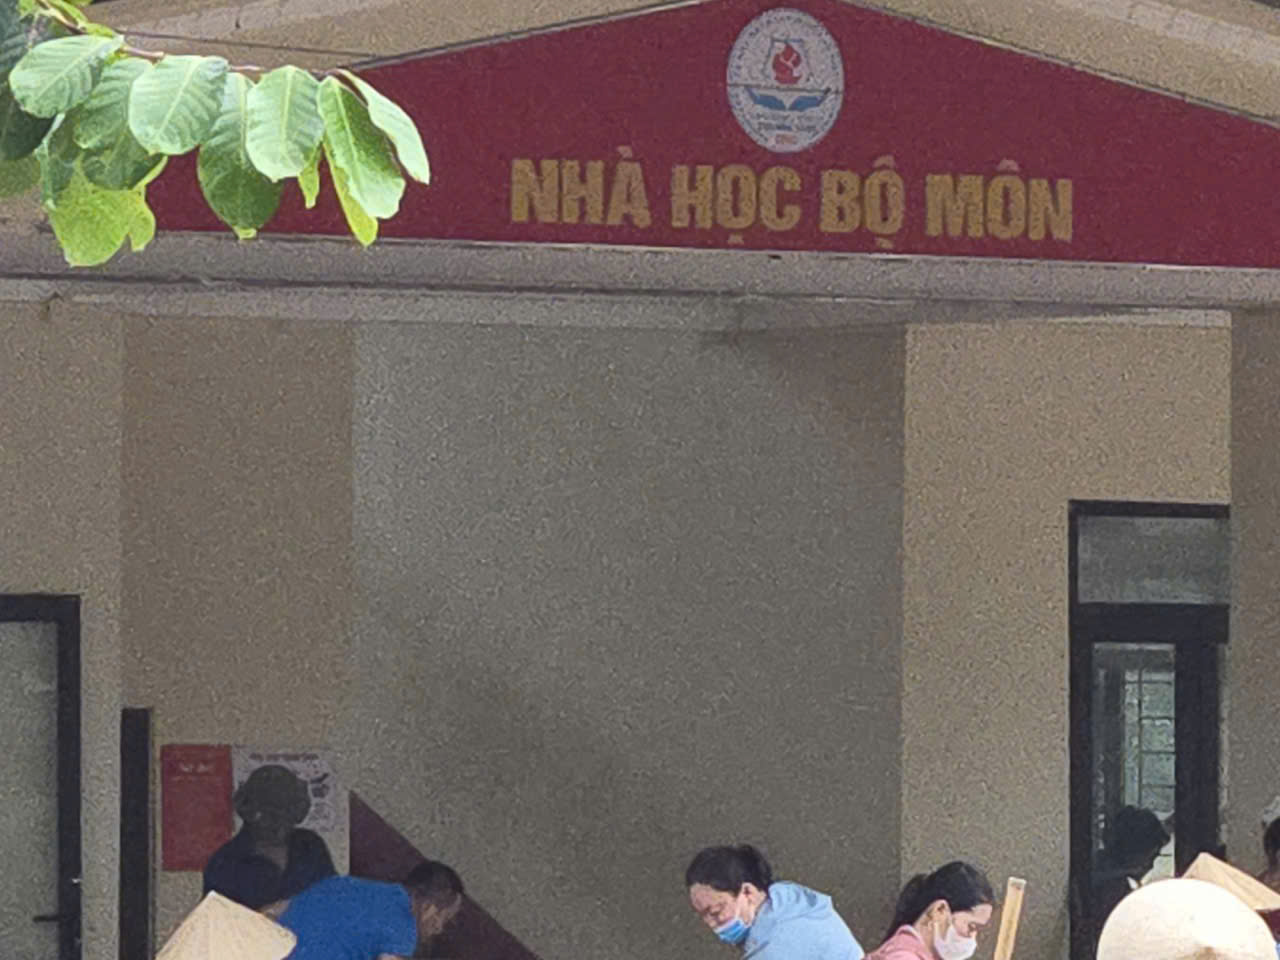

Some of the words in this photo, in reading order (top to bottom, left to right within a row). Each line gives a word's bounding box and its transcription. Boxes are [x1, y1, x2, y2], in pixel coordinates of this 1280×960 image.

[511, 145, 651, 228] NHÀ
[670, 164, 800, 243] HỌC
[819, 155, 904, 249] BỘ
[925, 158, 1073, 242] MÔN
